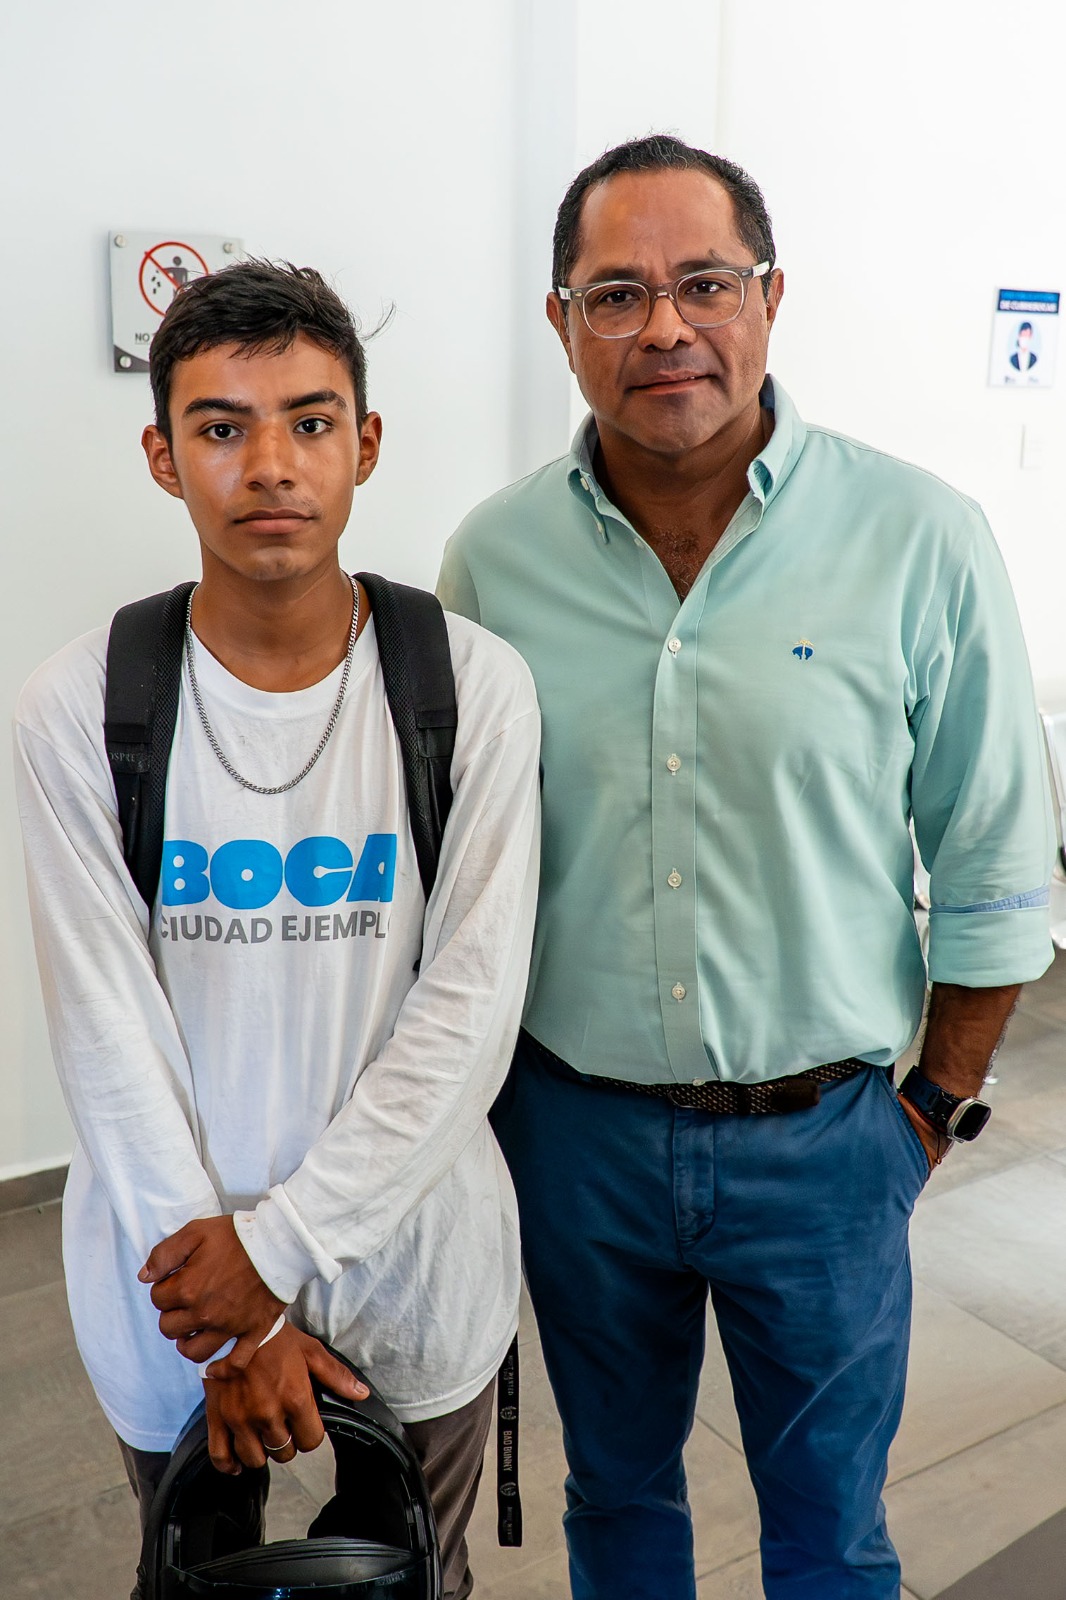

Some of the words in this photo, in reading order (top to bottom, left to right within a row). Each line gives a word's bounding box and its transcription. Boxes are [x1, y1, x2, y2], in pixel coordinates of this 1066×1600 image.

[135, 331, 150, 342] NO
[162, 834, 397, 909] BOCA
[281, 910, 391, 942] EJEMPL
[503, 1430, 513, 1446] BAD
[503, 1446, 513, 1472] BUNNY
